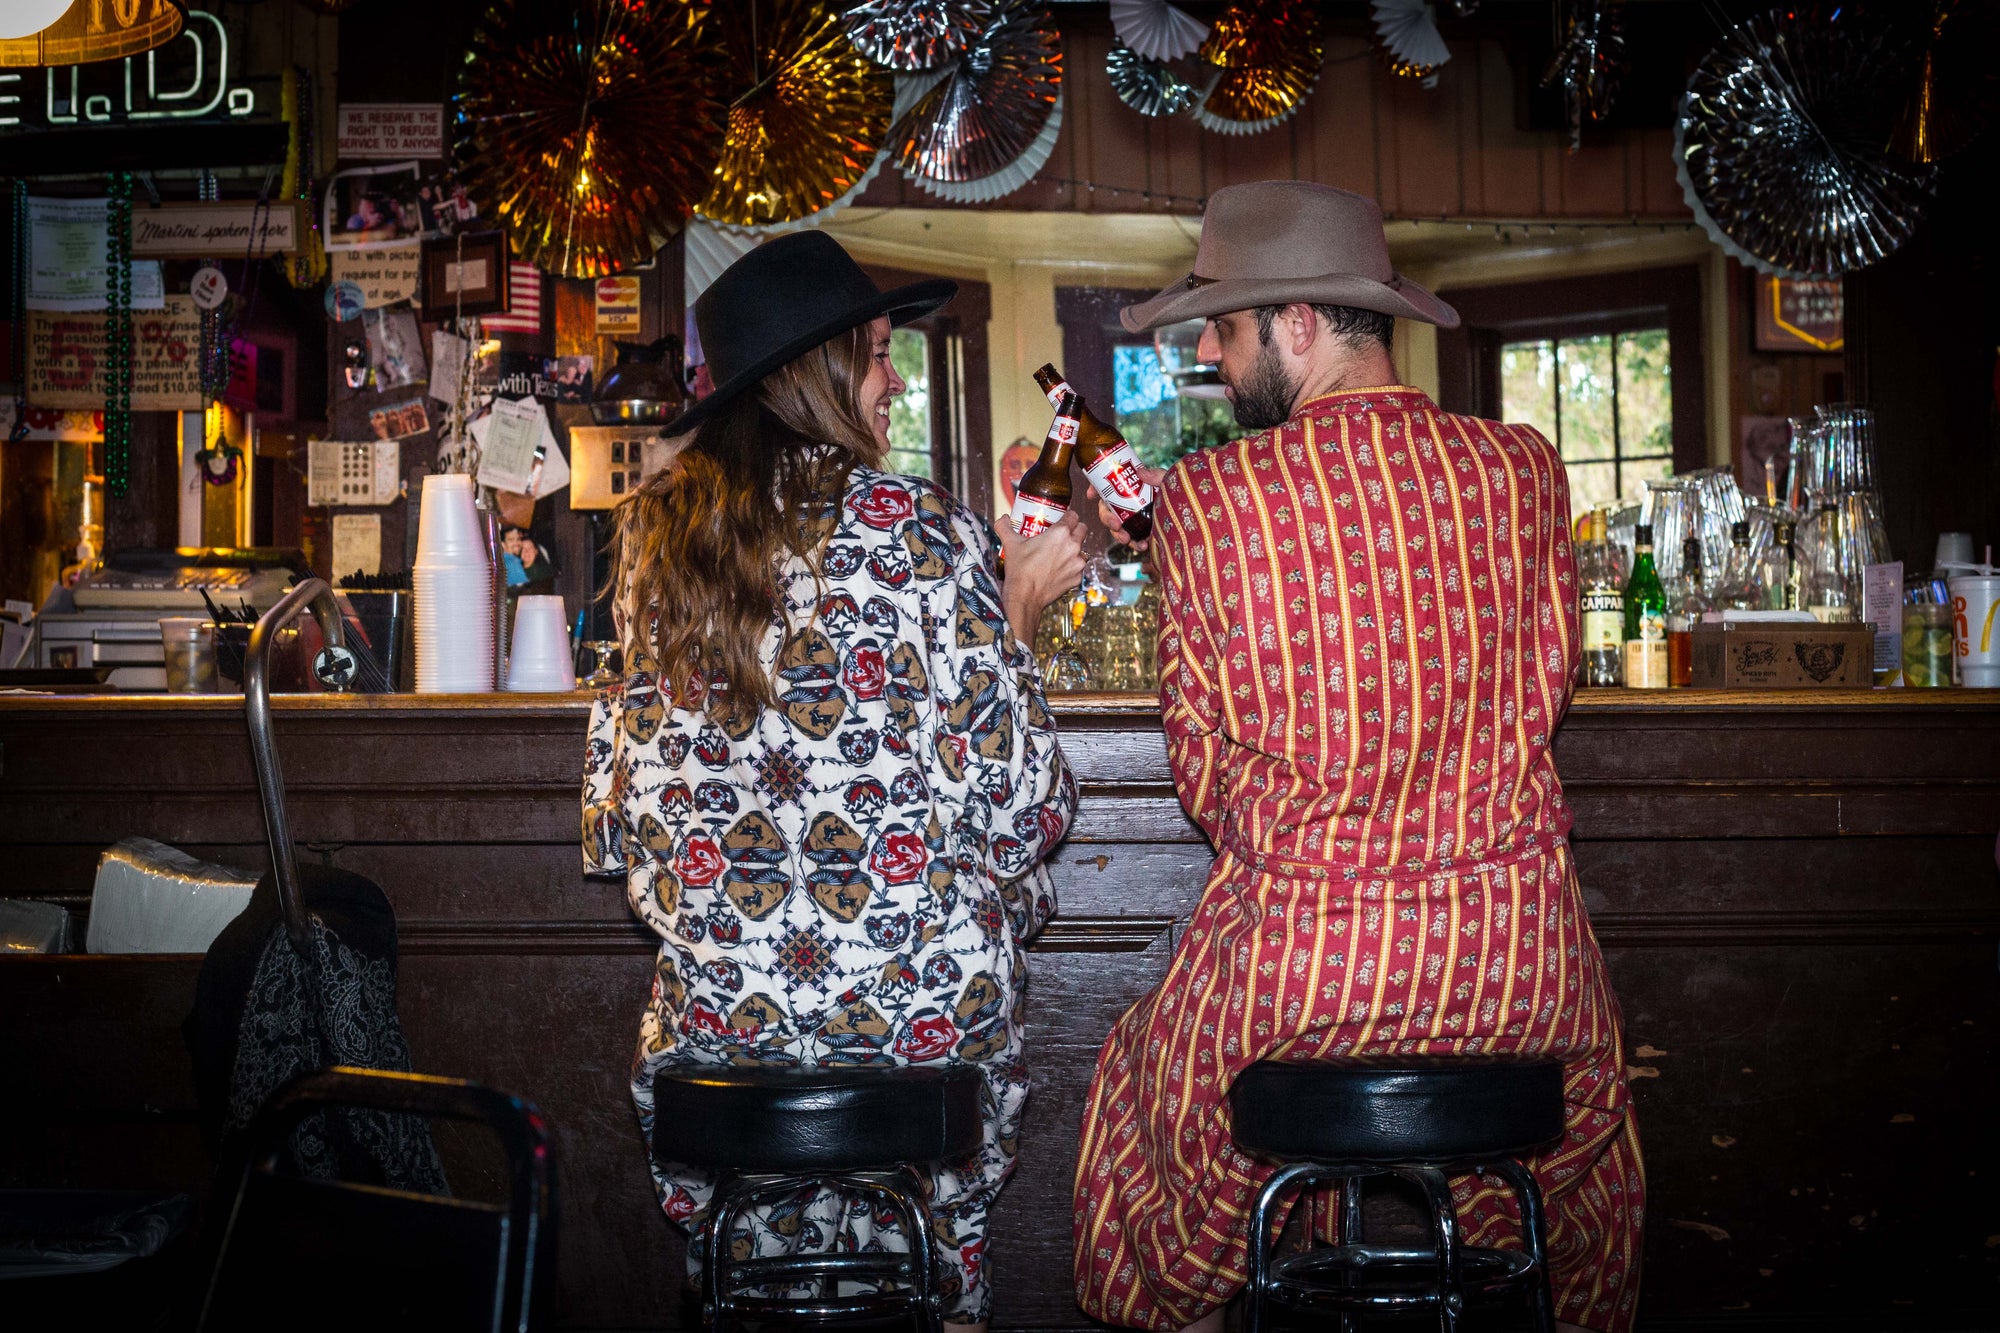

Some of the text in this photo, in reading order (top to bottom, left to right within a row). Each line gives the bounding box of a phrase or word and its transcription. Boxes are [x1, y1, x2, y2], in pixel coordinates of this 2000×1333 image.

[348, 112, 438, 123] WE RESERVE THE
[347, 125, 438, 136] RIGHT TO REFUSE
[338, 138, 443, 149] SERVICE TO ANYONE
[138, 219, 289, 243] Martini spoken here
[366, 250, 386, 260] with
[341, 269, 381, 281] required
[385, 269, 399, 280] for
[368, 289, 379, 299] of
[36, 319, 58, 331] The
[35, 357, 62, 368] with
[146, 358, 190, 371] penalty
[33, 369, 46, 380] 10
[43, 381, 66, 392] fine
[72, 382, 92, 392] not
[497, 371, 532, 394] with
[1117, 474, 1139, 493] SAR
[1024, 520, 1049, 534] LONE
[1581, 596, 1624, 611] CAMPAR
